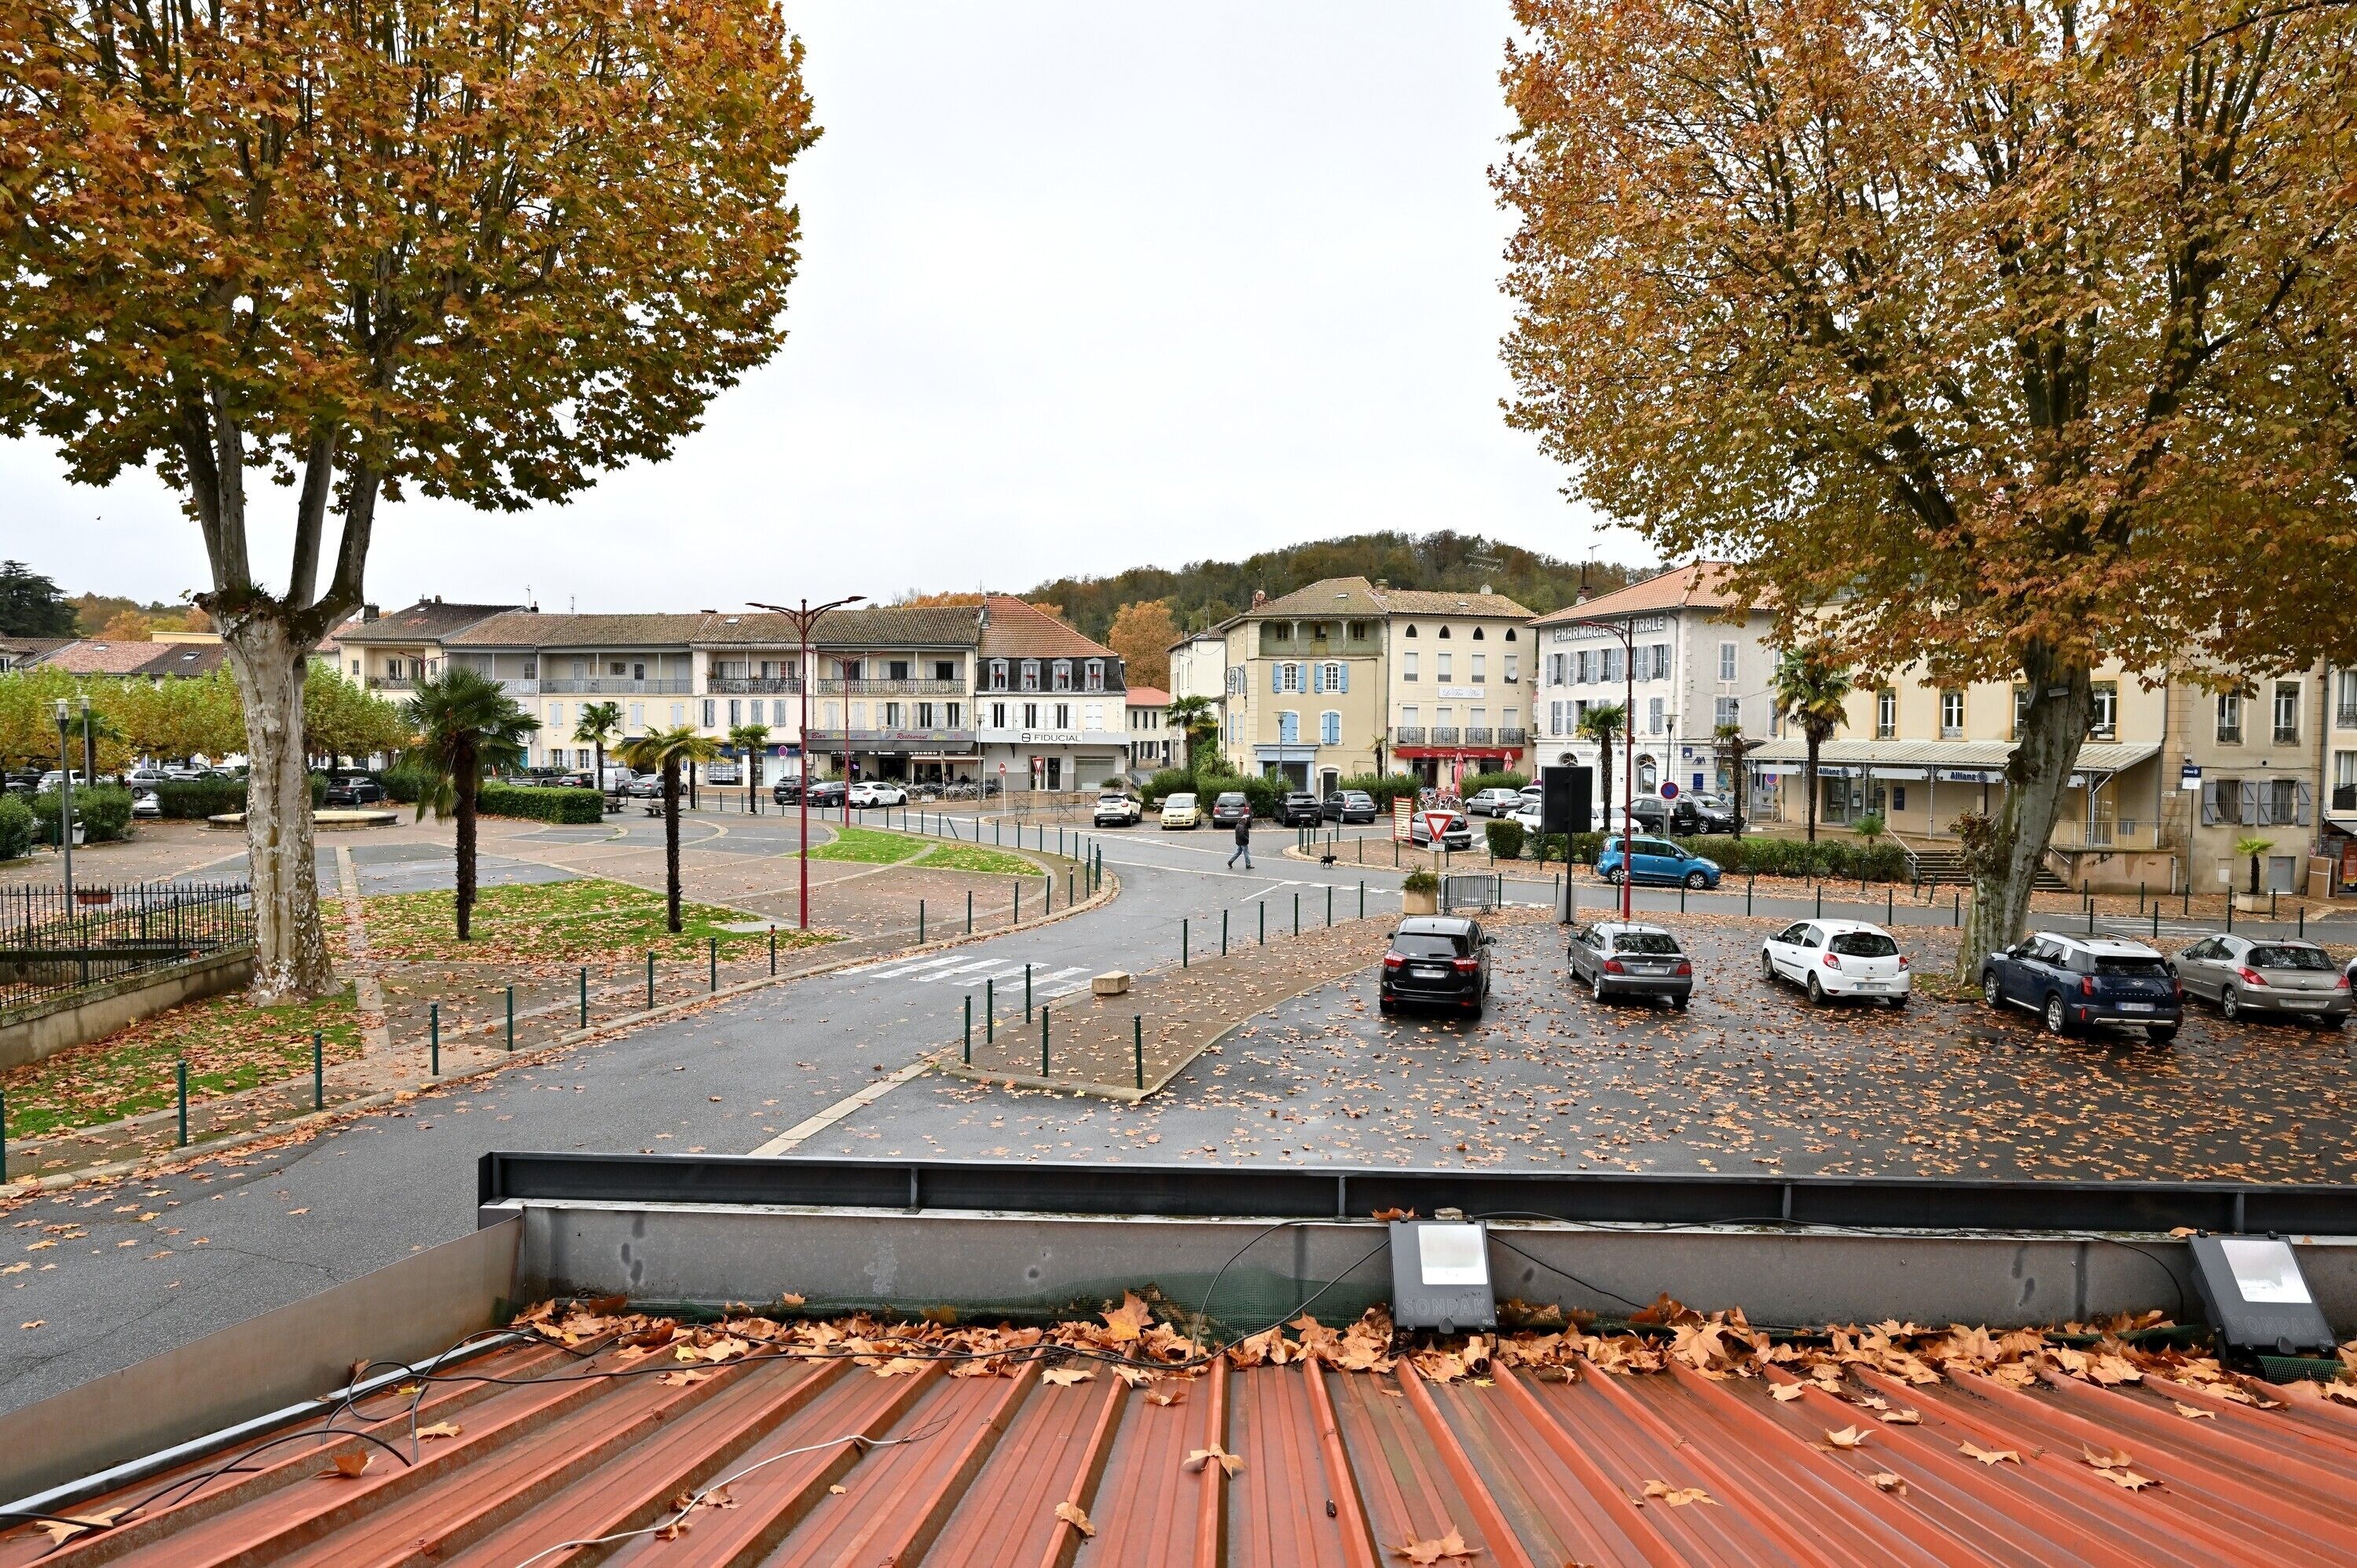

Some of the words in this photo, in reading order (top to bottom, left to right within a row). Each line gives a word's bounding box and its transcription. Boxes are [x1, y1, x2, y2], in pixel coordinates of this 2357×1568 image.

[1554, 625, 1607, 643] PHARMACIE
[1034, 734, 1082, 742] FIDUCIAL
[1692, 756, 1706, 764] AXA
[1818, 767, 1840, 776] Allianz
[1950, 771, 1976, 781] Allianz
[1402, 1298, 1488, 1317] SONPAK
[2229, 1315, 2322, 1335] SONPAK
